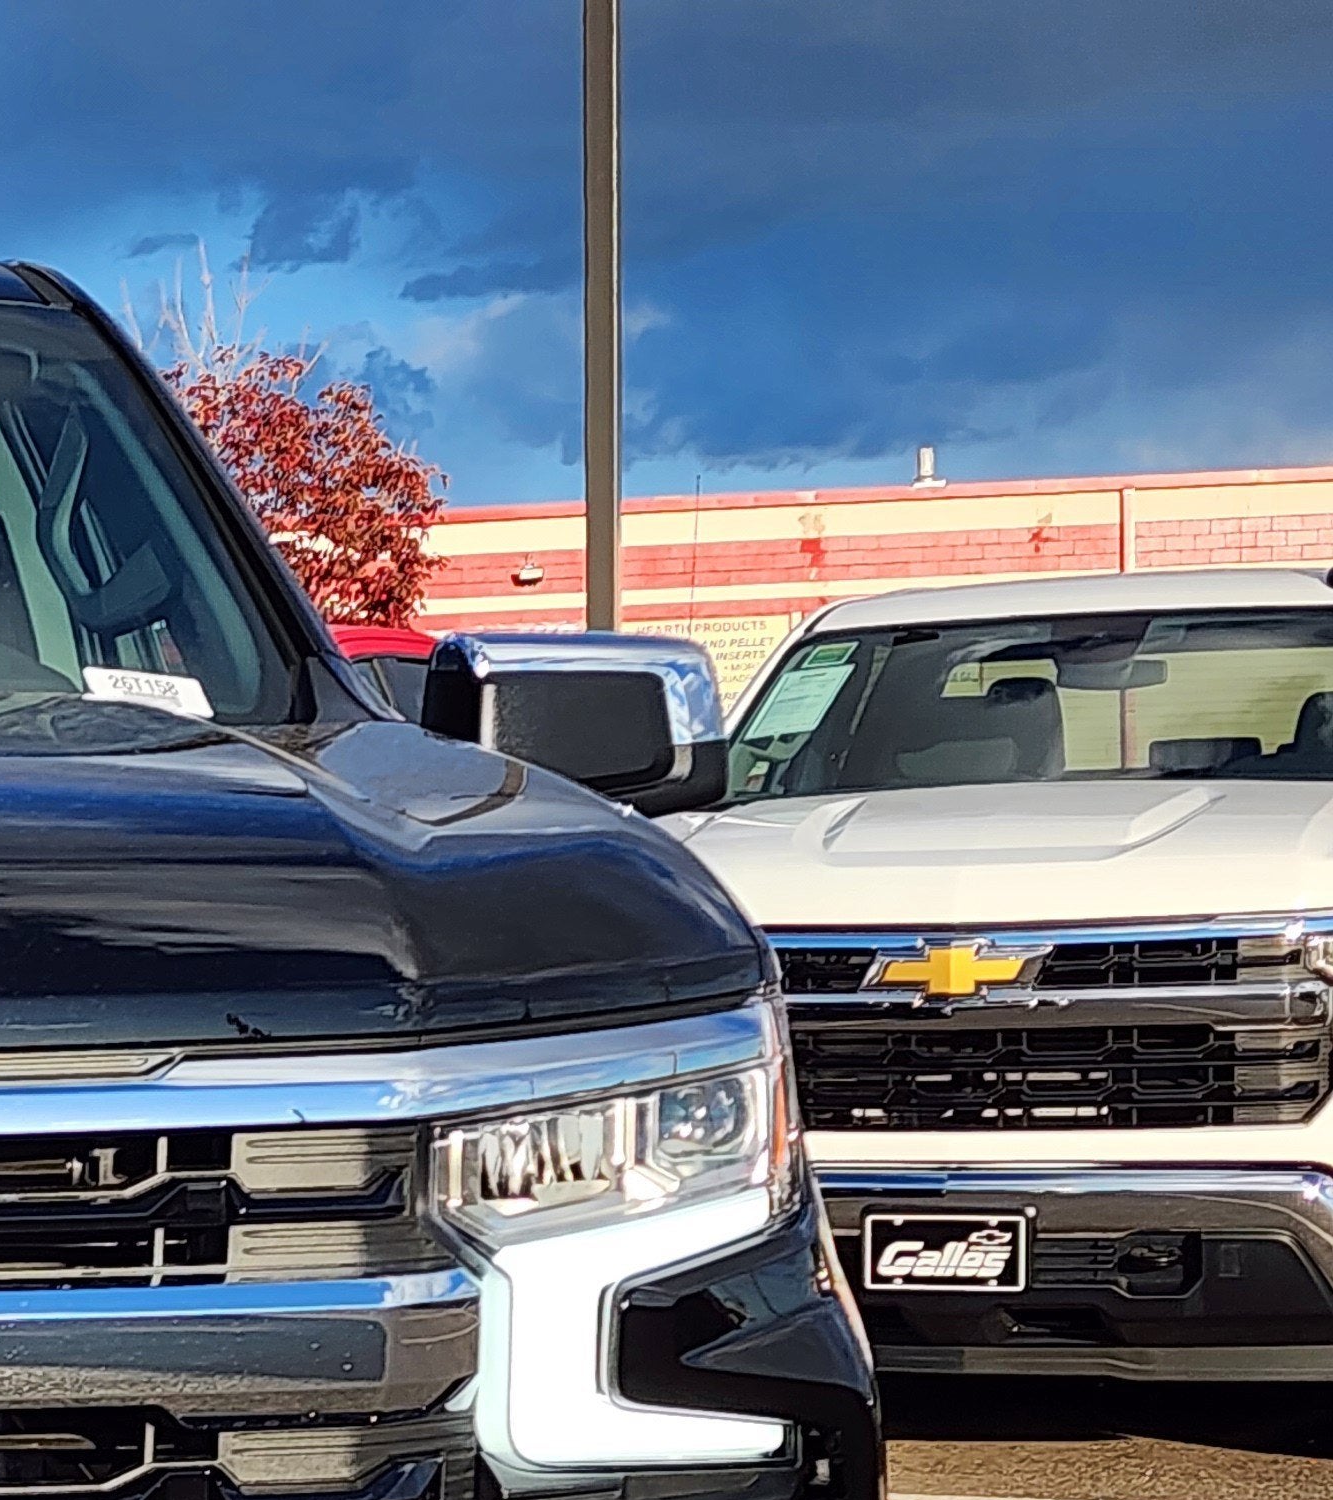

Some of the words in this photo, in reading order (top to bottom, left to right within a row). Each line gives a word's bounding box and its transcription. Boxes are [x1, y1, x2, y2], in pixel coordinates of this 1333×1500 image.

[694, 620, 768, 633] PRODUCTS
[732, 636, 775, 648] PELLET
[715, 650, 766, 661] INSERTS
[108, 674, 179, 696] 26T158
[876, 1241, 1011, 1278] Galles
